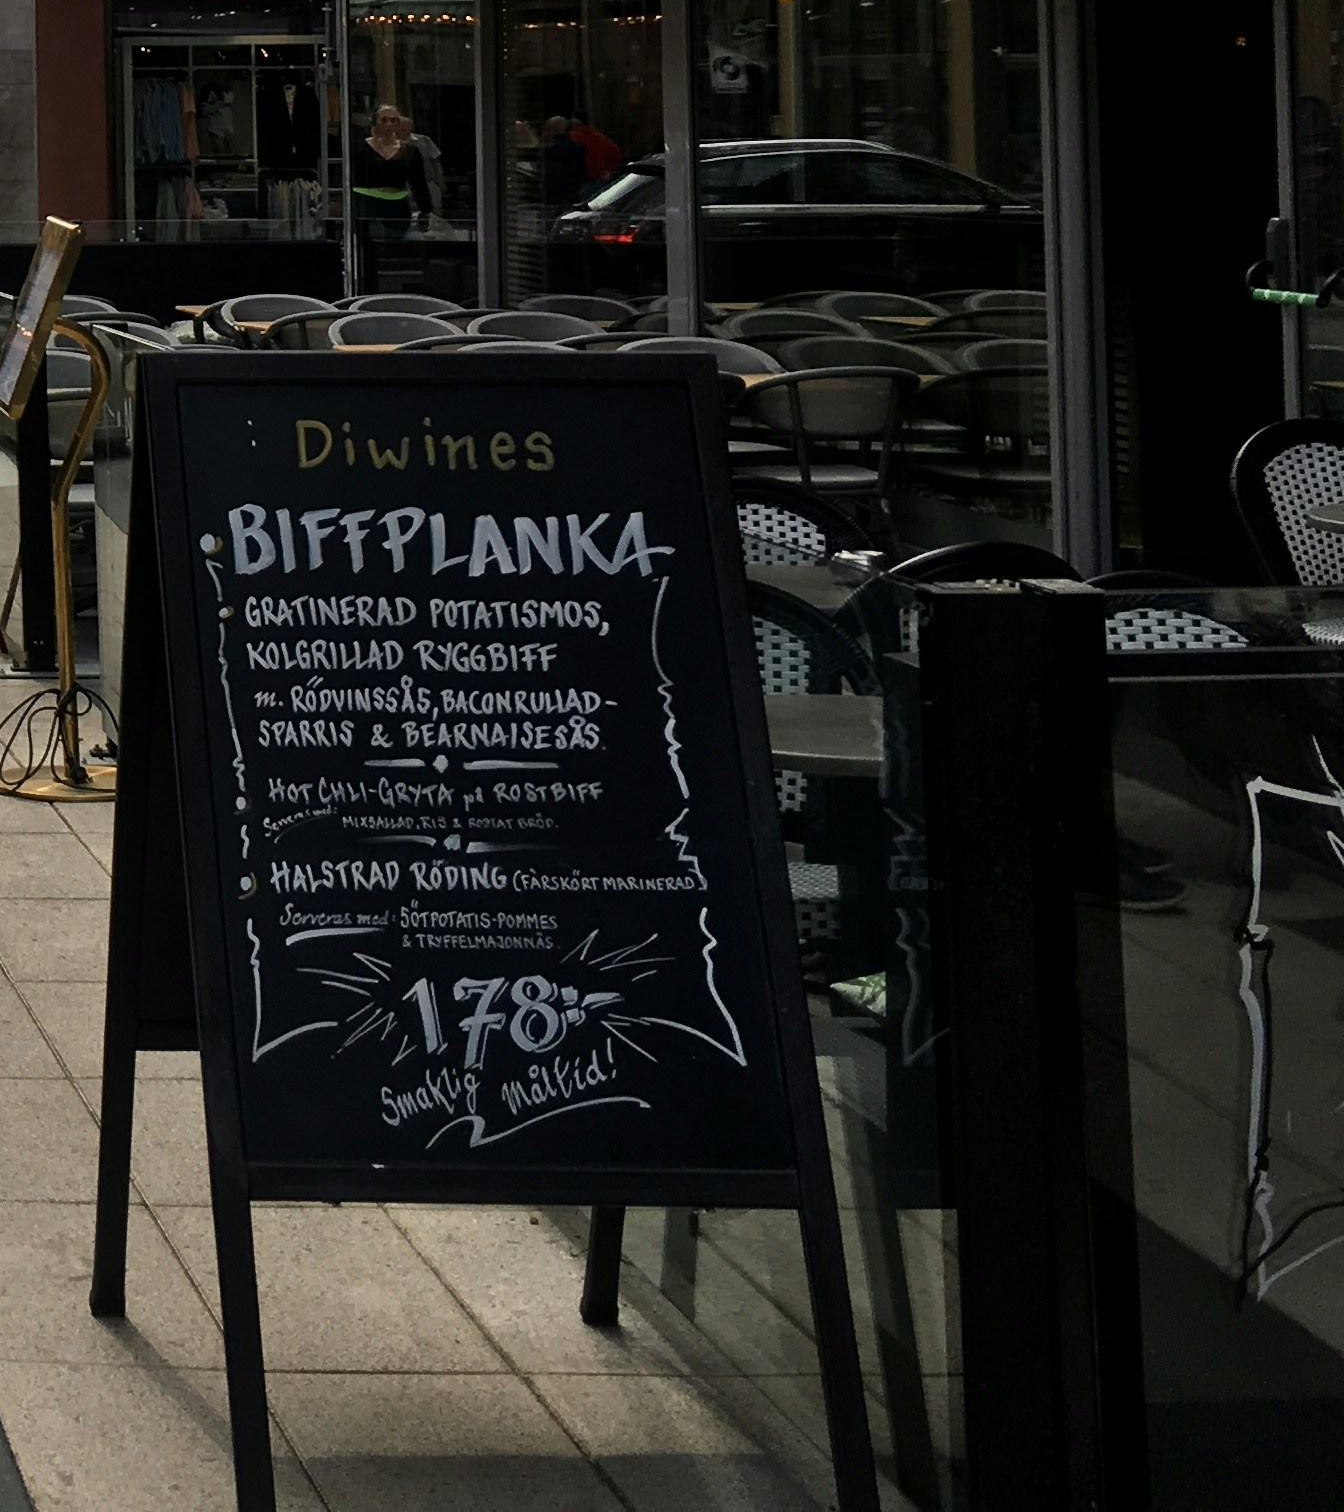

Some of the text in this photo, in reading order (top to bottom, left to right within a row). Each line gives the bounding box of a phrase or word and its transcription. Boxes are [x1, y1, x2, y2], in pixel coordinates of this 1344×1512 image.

[295, 417, 555, 473] Diwines
[227, 503, 675, 577] BIFFPLANKA
[244, 594, 610, 636] GRATINERAD POTATISMOS,
[246, 638, 560, 673] KOLGRILLAD RYGGBIFF
[257, 719, 355, 749] SPARRIS
[369, 723, 394, 748] &
[267, 776, 313, 805] HOT
[492, 781, 605, 805] ROSTBIFF
[269, 859, 401, 894] HALSTRAD
[410, 855, 510, 893] RÖDING
[400, 934, 412, 949] &
[380, 1065, 482, 1127] Smaklig
